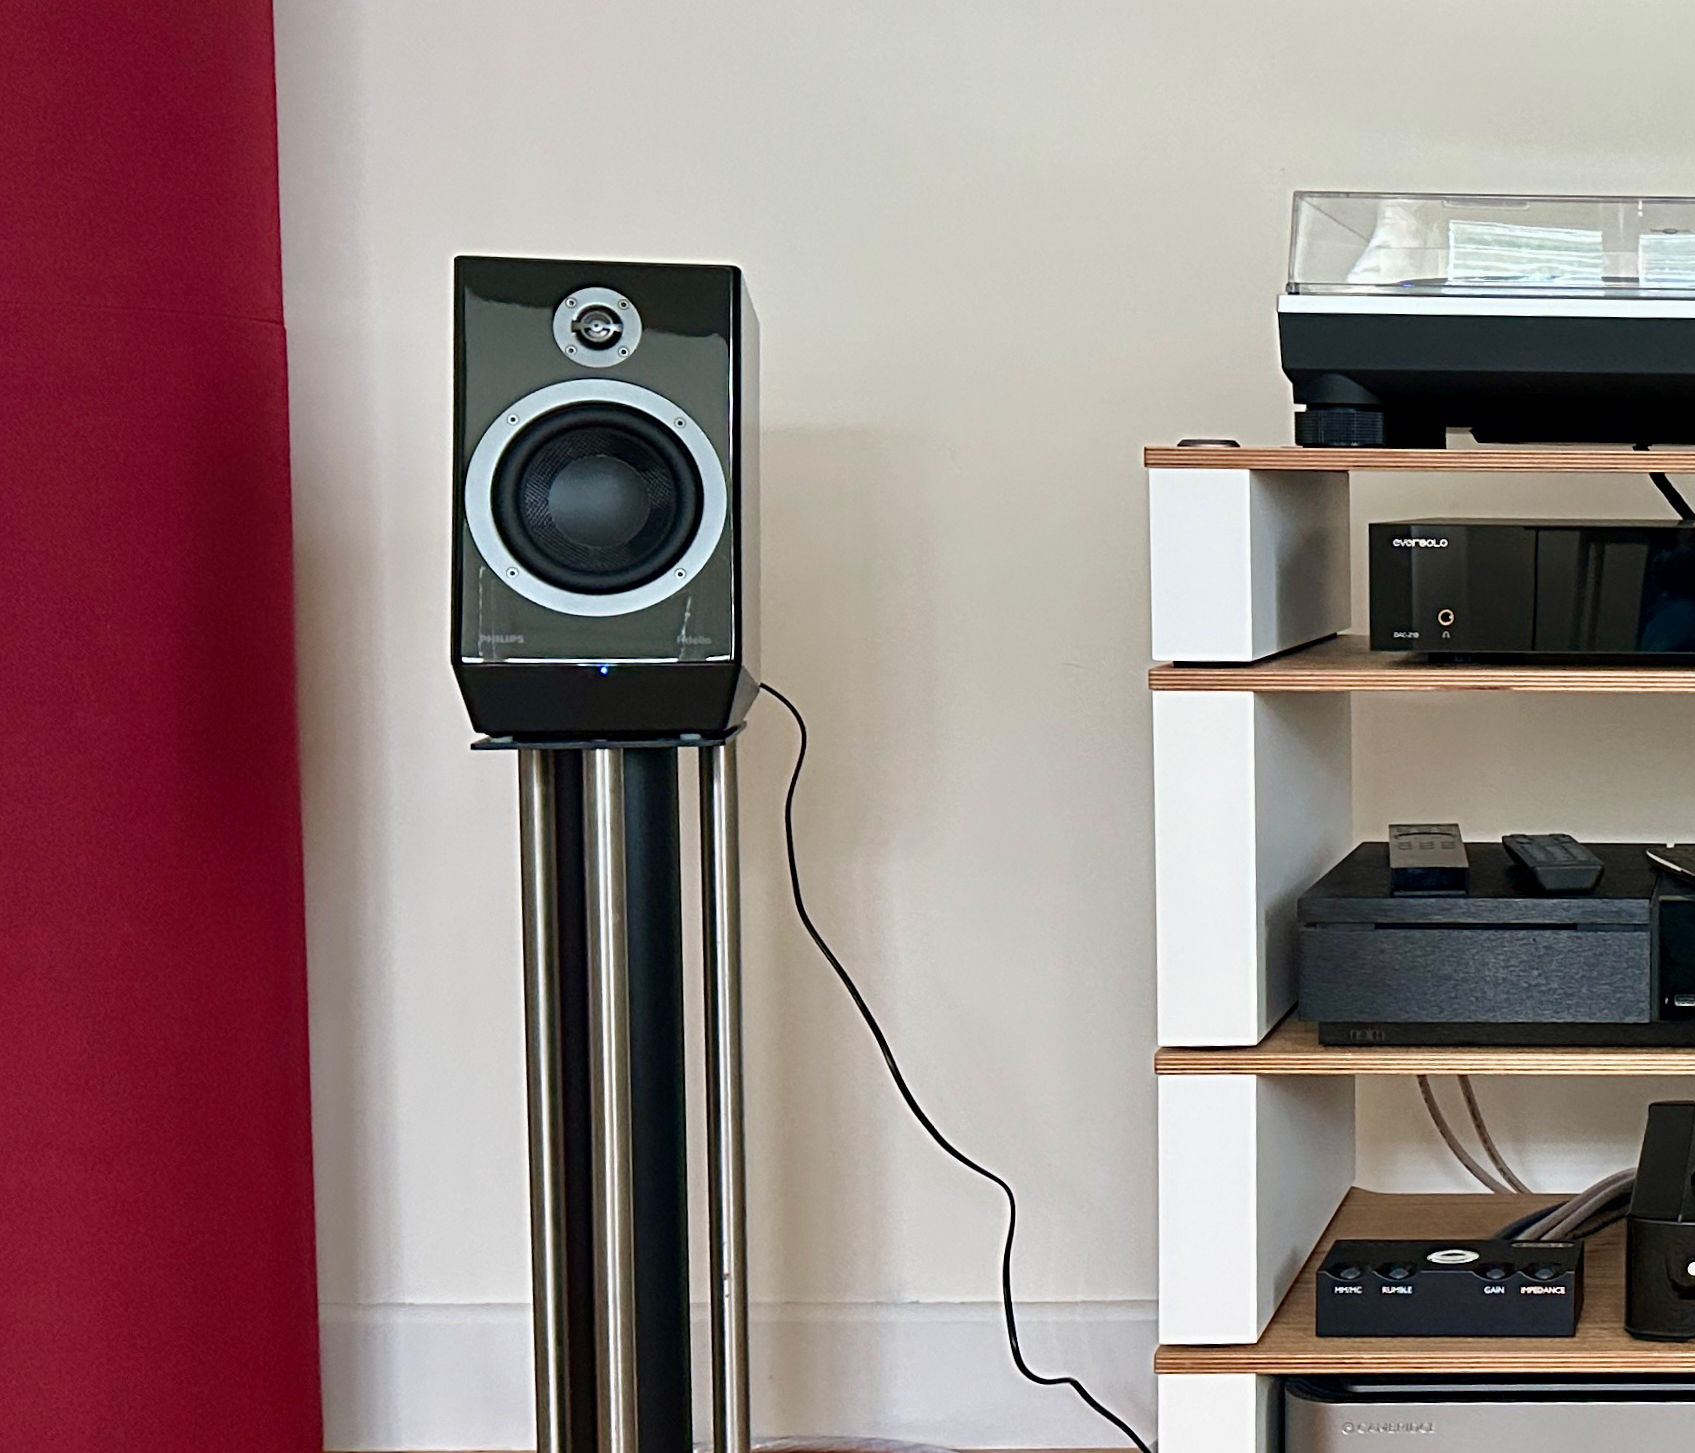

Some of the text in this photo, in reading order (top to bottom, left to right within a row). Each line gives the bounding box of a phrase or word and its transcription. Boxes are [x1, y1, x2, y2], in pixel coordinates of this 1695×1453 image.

[1381, 1285, 1413, 1295] RUMBLE
[1483, 1285, 1506, 1295] GAIN
[1520, 1285, 1566, 1295] IMPEDANCE
